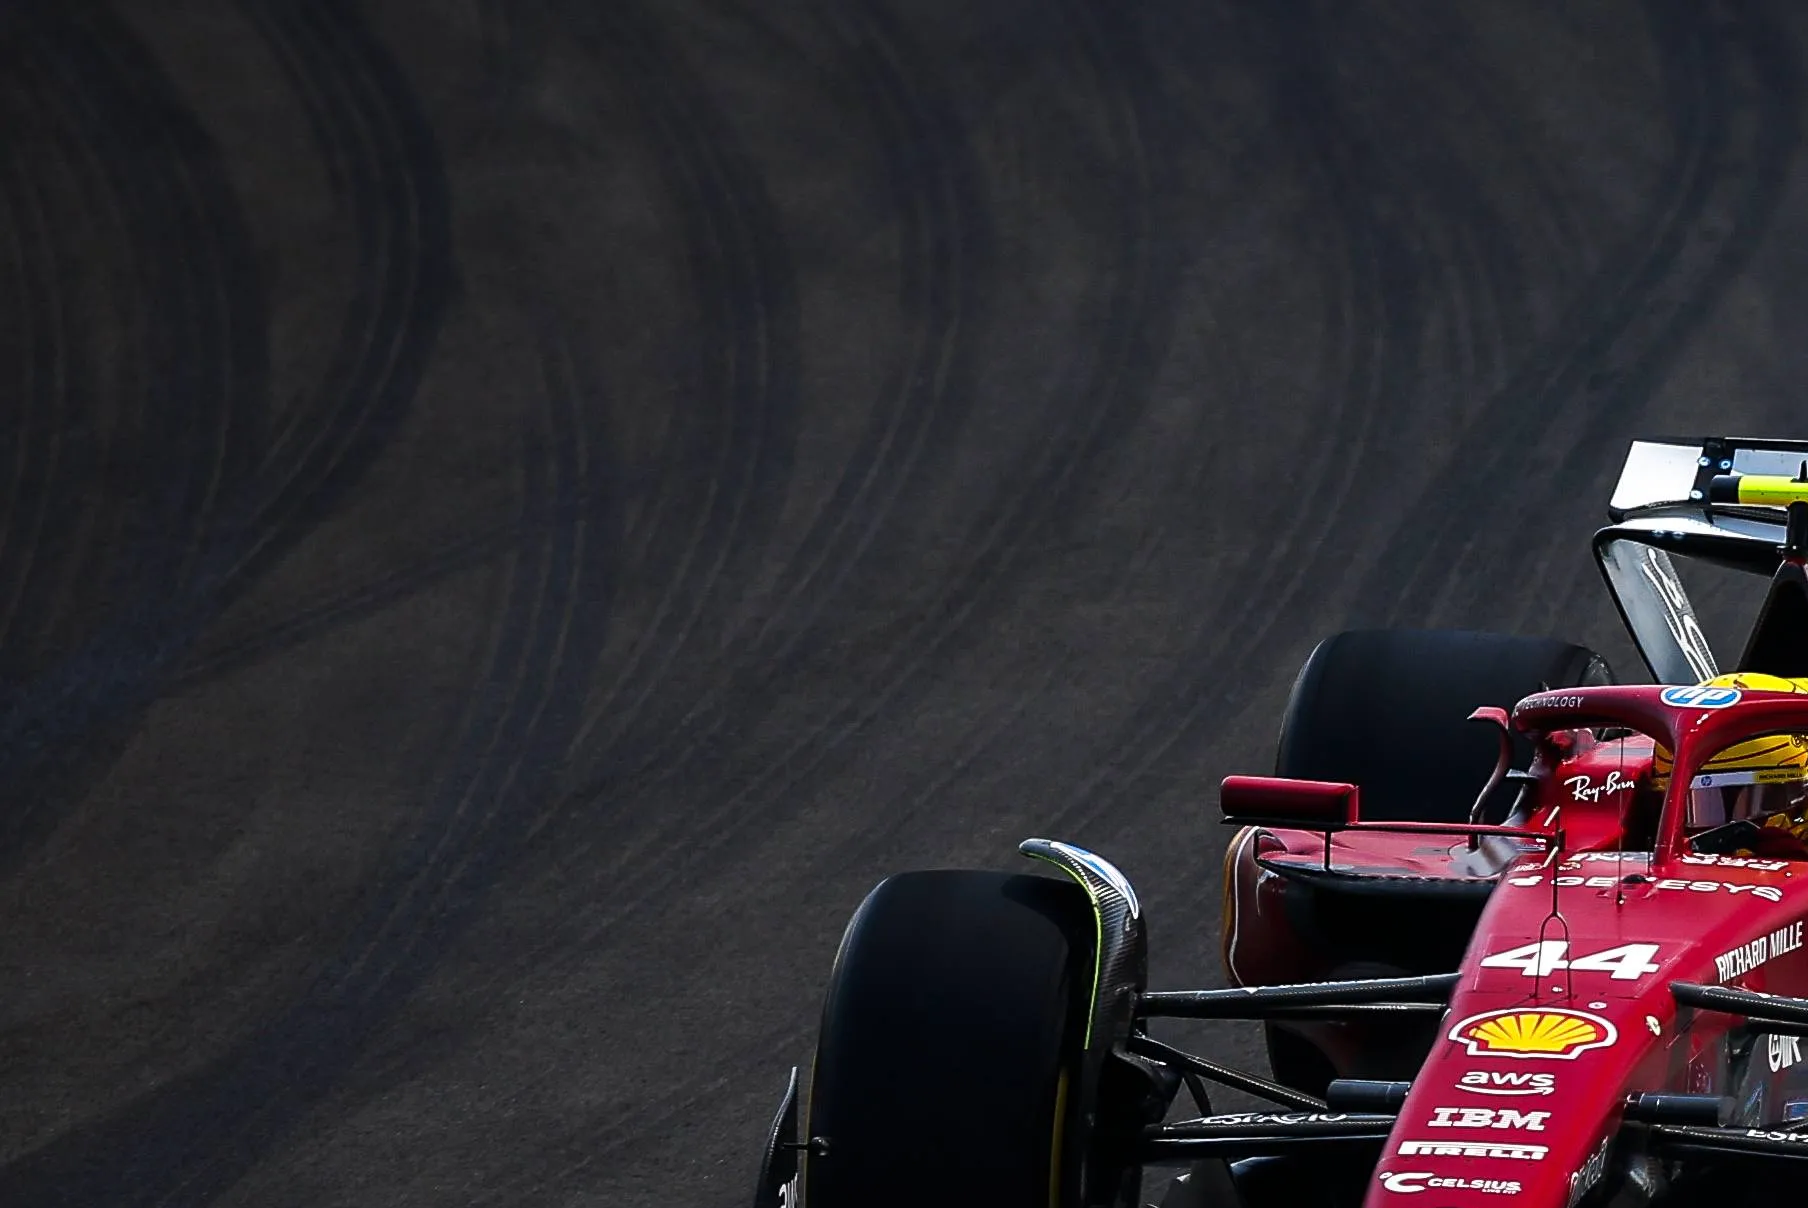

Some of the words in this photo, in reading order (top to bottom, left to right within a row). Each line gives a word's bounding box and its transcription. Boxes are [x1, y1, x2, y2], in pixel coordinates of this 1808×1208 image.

[1672, 685, 1727, 706] hp
[1551, 875, 1784, 902] GEESYS
[1479, 940, 1661, 981] 44
[1714, 936, 1768, 983] RICHARD
[1768, 921, 1804, 958] MILLE
[1461, 1070, 1555, 1088] aws
[1427, 1107, 1551, 1131] IBM
[1397, 1141, 1549, 1160] PIRELLI
[1426, 1177, 1521, 1192] CELSIUS
